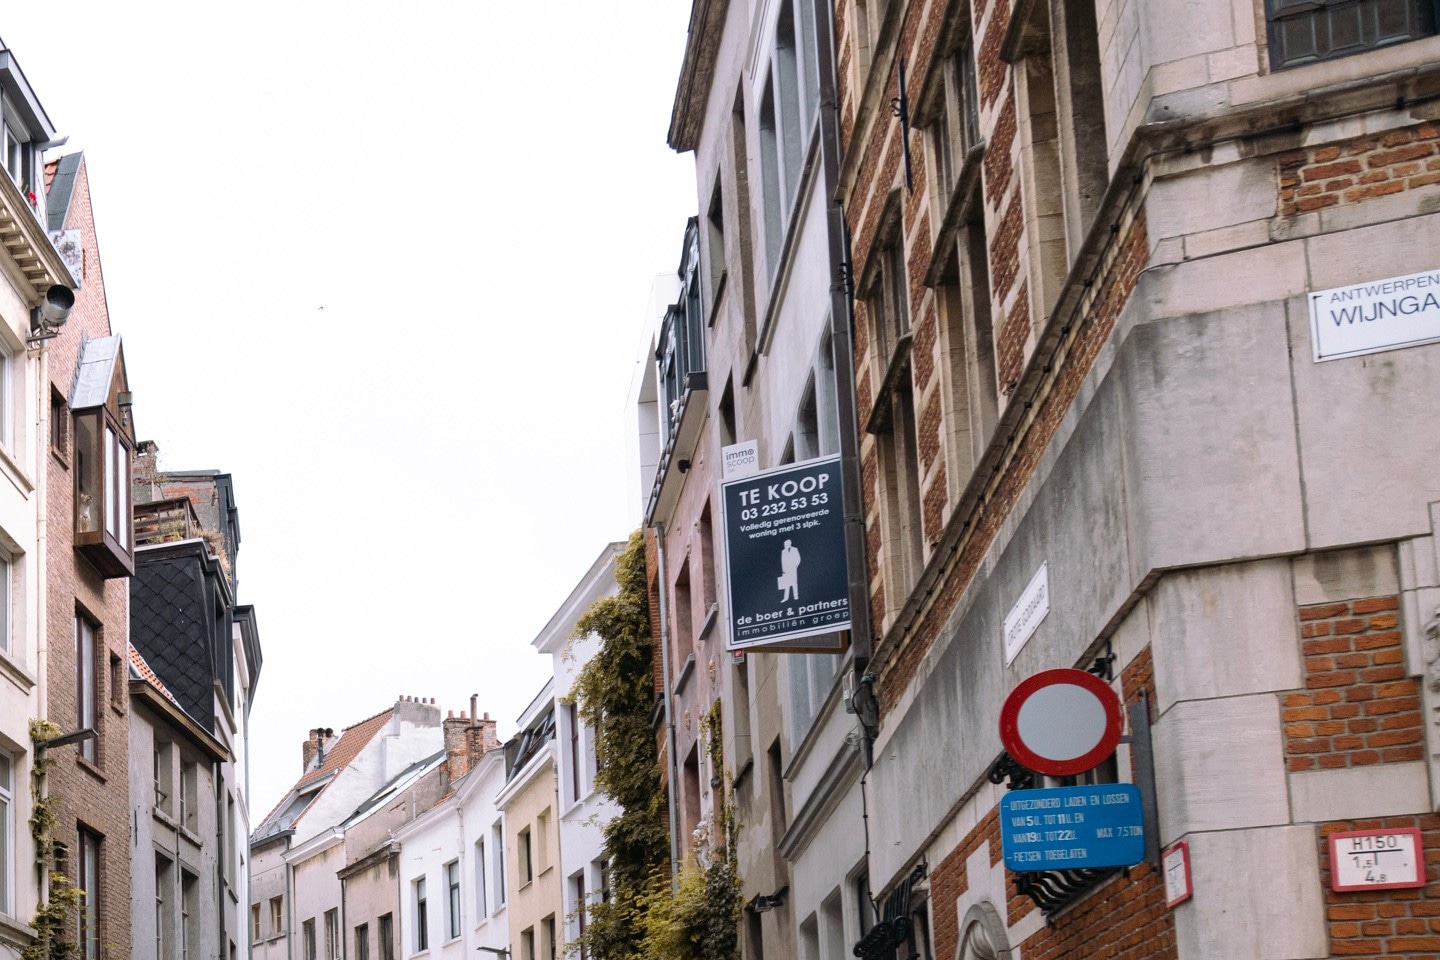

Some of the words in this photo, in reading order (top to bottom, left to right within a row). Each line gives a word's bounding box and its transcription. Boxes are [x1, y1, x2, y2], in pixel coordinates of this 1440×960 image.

[1329, 273, 1440, 304] ANTWERPEN
[726, 448, 755, 461] immo
[726, 455, 755, 468] scoop
[739, 488, 760, 507] TE
[767, 473, 830, 501] KOOP
[741, 507, 759, 521] 03
[761, 501, 787, 517] 232
[790, 497, 808, 510] 53
[811, 492, 829, 506] 53
[740, 520, 772, 533] Volledig
[773, 508, 830, 528] gerenoveerde
[748, 527, 778, 540] woning
[778, 523, 795, 534] met
[795, 522, 802, 531] 3
[737, 615, 753, 626] de
[756, 609, 783, 622] boer
[786, 607, 795, 616] &
[798, 598, 849, 616] partners
[737, 619, 806, 637] immobiliën
[812, 611, 849, 625] groep
[1010, 797, 1061, 811] UITGEZONDERD
[1064, 795, 1087, 808] LADEN
[1090, 794, 1100, 806] EN
[1102, 793, 1130, 805] LOSSEN
[1074, 812, 1084, 823] EN
[1096, 827, 1113, 839] MAX
[1352, 835, 1398, 851] H150
[1013, 850, 1042, 863] FIETSEN
[1044, 848, 1088, 861] TOEGELATEN
